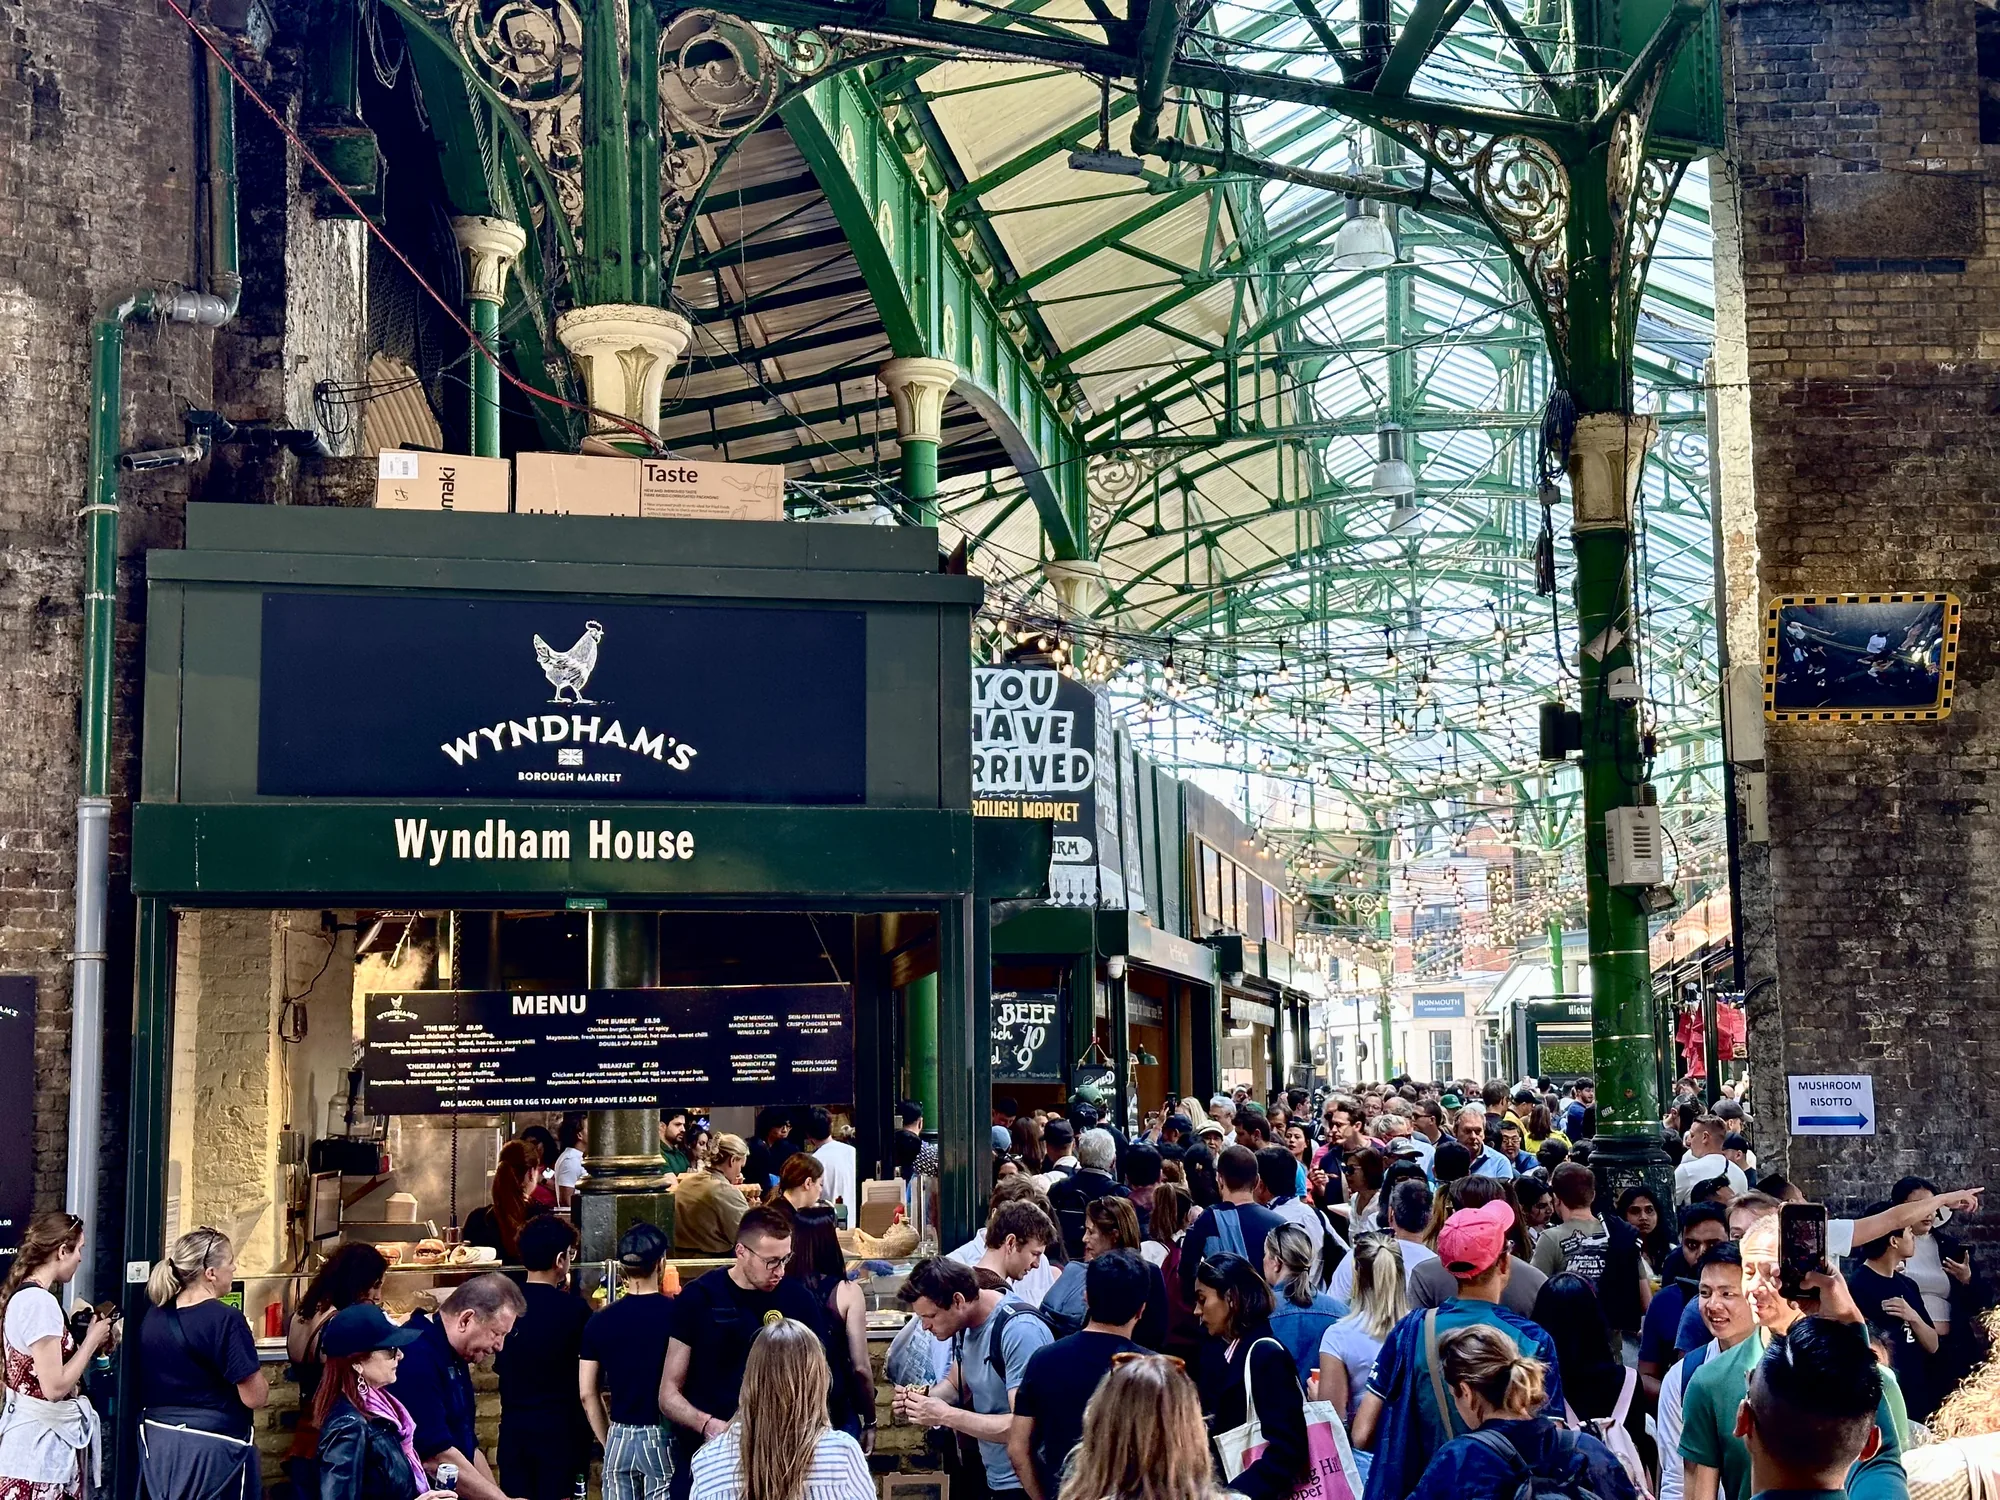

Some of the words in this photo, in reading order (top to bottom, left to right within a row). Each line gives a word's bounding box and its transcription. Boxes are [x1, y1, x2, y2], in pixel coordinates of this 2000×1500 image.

[644, 464, 698, 483] Taste
[438, 467, 456, 511] maki
[976, 674, 1053, 706] YOU
[441, 715, 698, 771] WYNDHAM'S
[518, 772, 574, 782] BOROUGH
[577, 773, 622, 782] MARKET
[972, 755, 1089, 788] RRIVED
[973, 800, 1018, 818] ROUGH
[1022, 801, 1080, 822] MARKET
[394, 819, 570, 867] Wyndham
[589, 819, 695, 860] House
[512, 995, 587, 1014] MENU
[997, 1003, 1056, 1026] BEEF
[1798, 1082, 1861, 1090] MUSHROOM
[1810, 1098, 1852, 1106] RISOTTO
